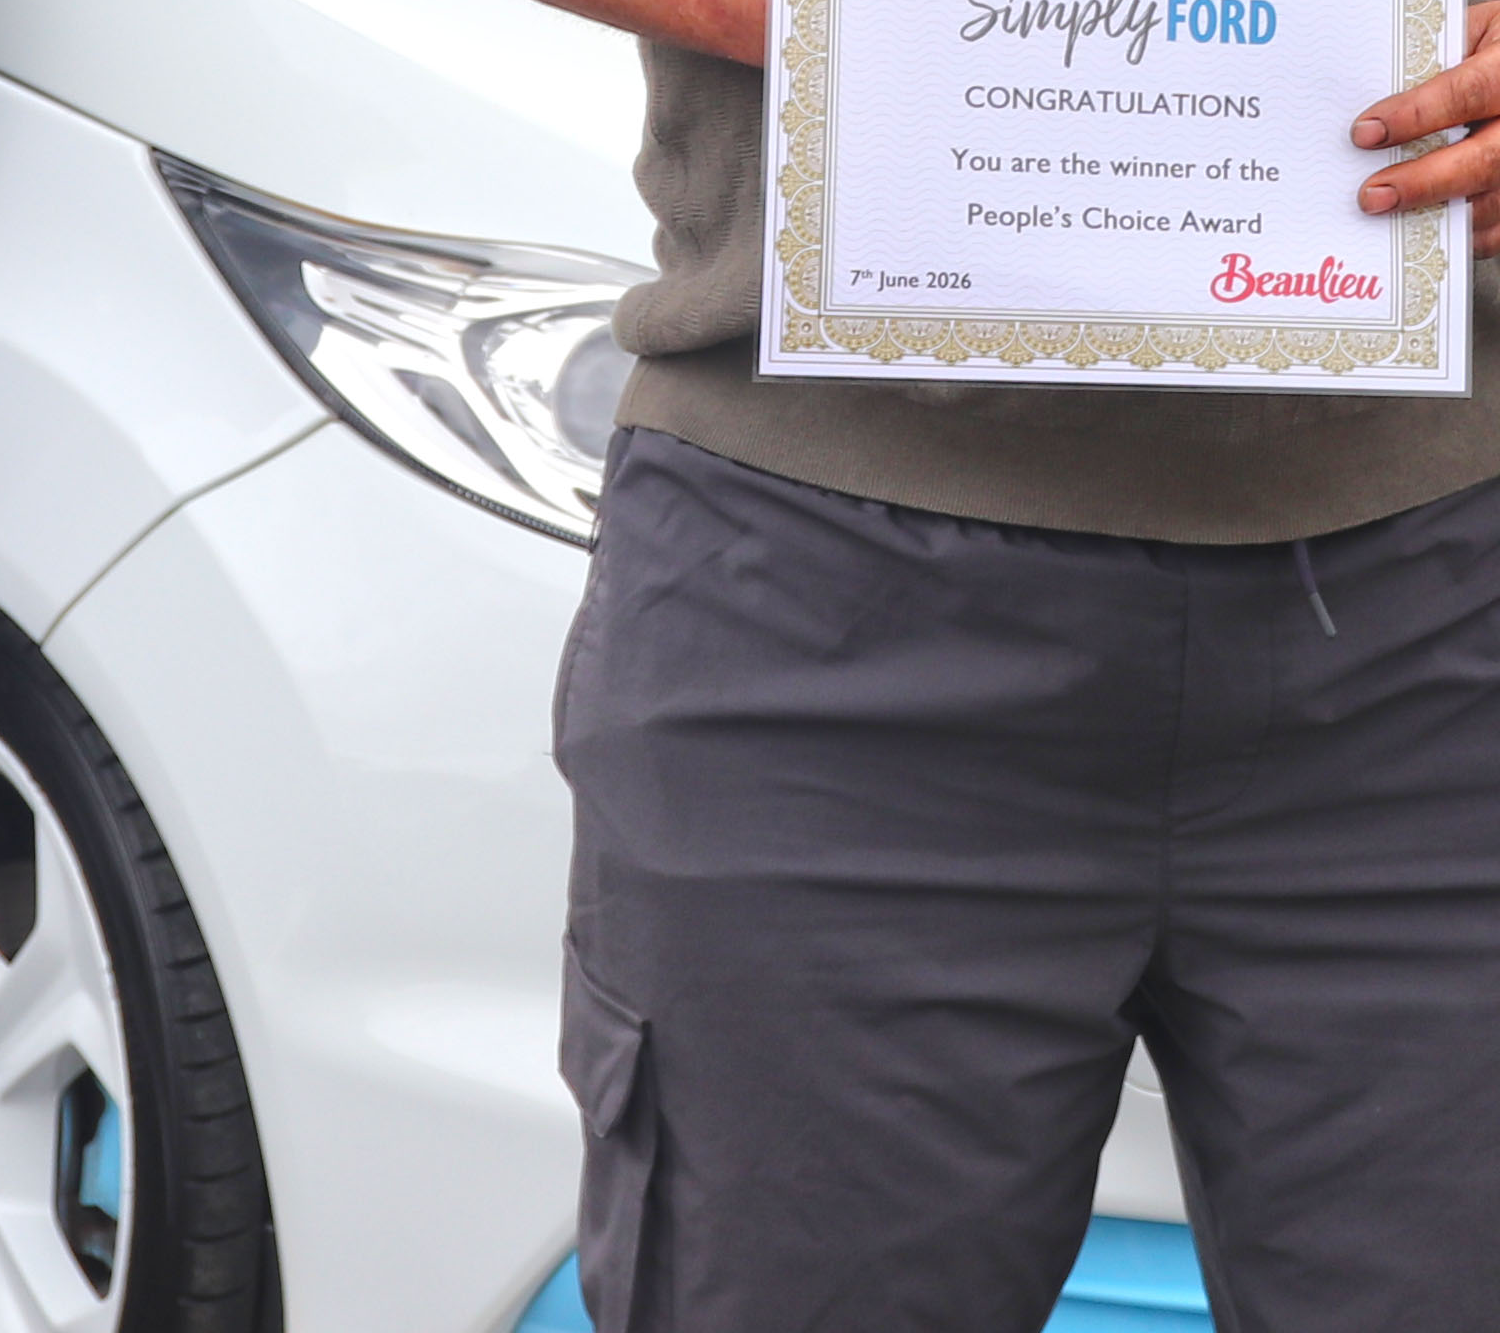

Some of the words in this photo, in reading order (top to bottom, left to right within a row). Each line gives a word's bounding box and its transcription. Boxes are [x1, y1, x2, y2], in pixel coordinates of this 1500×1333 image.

[965, 85, 1261, 118] CONGRATULATIONS
[950, 148, 1001, 171] You
[1011, 157, 1051, 173] are
[1061, 153, 1100, 175] the
[1110, 157, 1196, 179] winner
[1205, 158, 1233, 180] of
[1240, 159, 1280, 182] the
[1082, 207, 1170, 231] Choice
[1180, 210, 1262, 234] Award
[850, 269, 873, 286] 7th
[877, 270, 919, 292] June
[925, 272, 972, 289] 2026
[1210, 253, 1383, 303] Beaulieu
